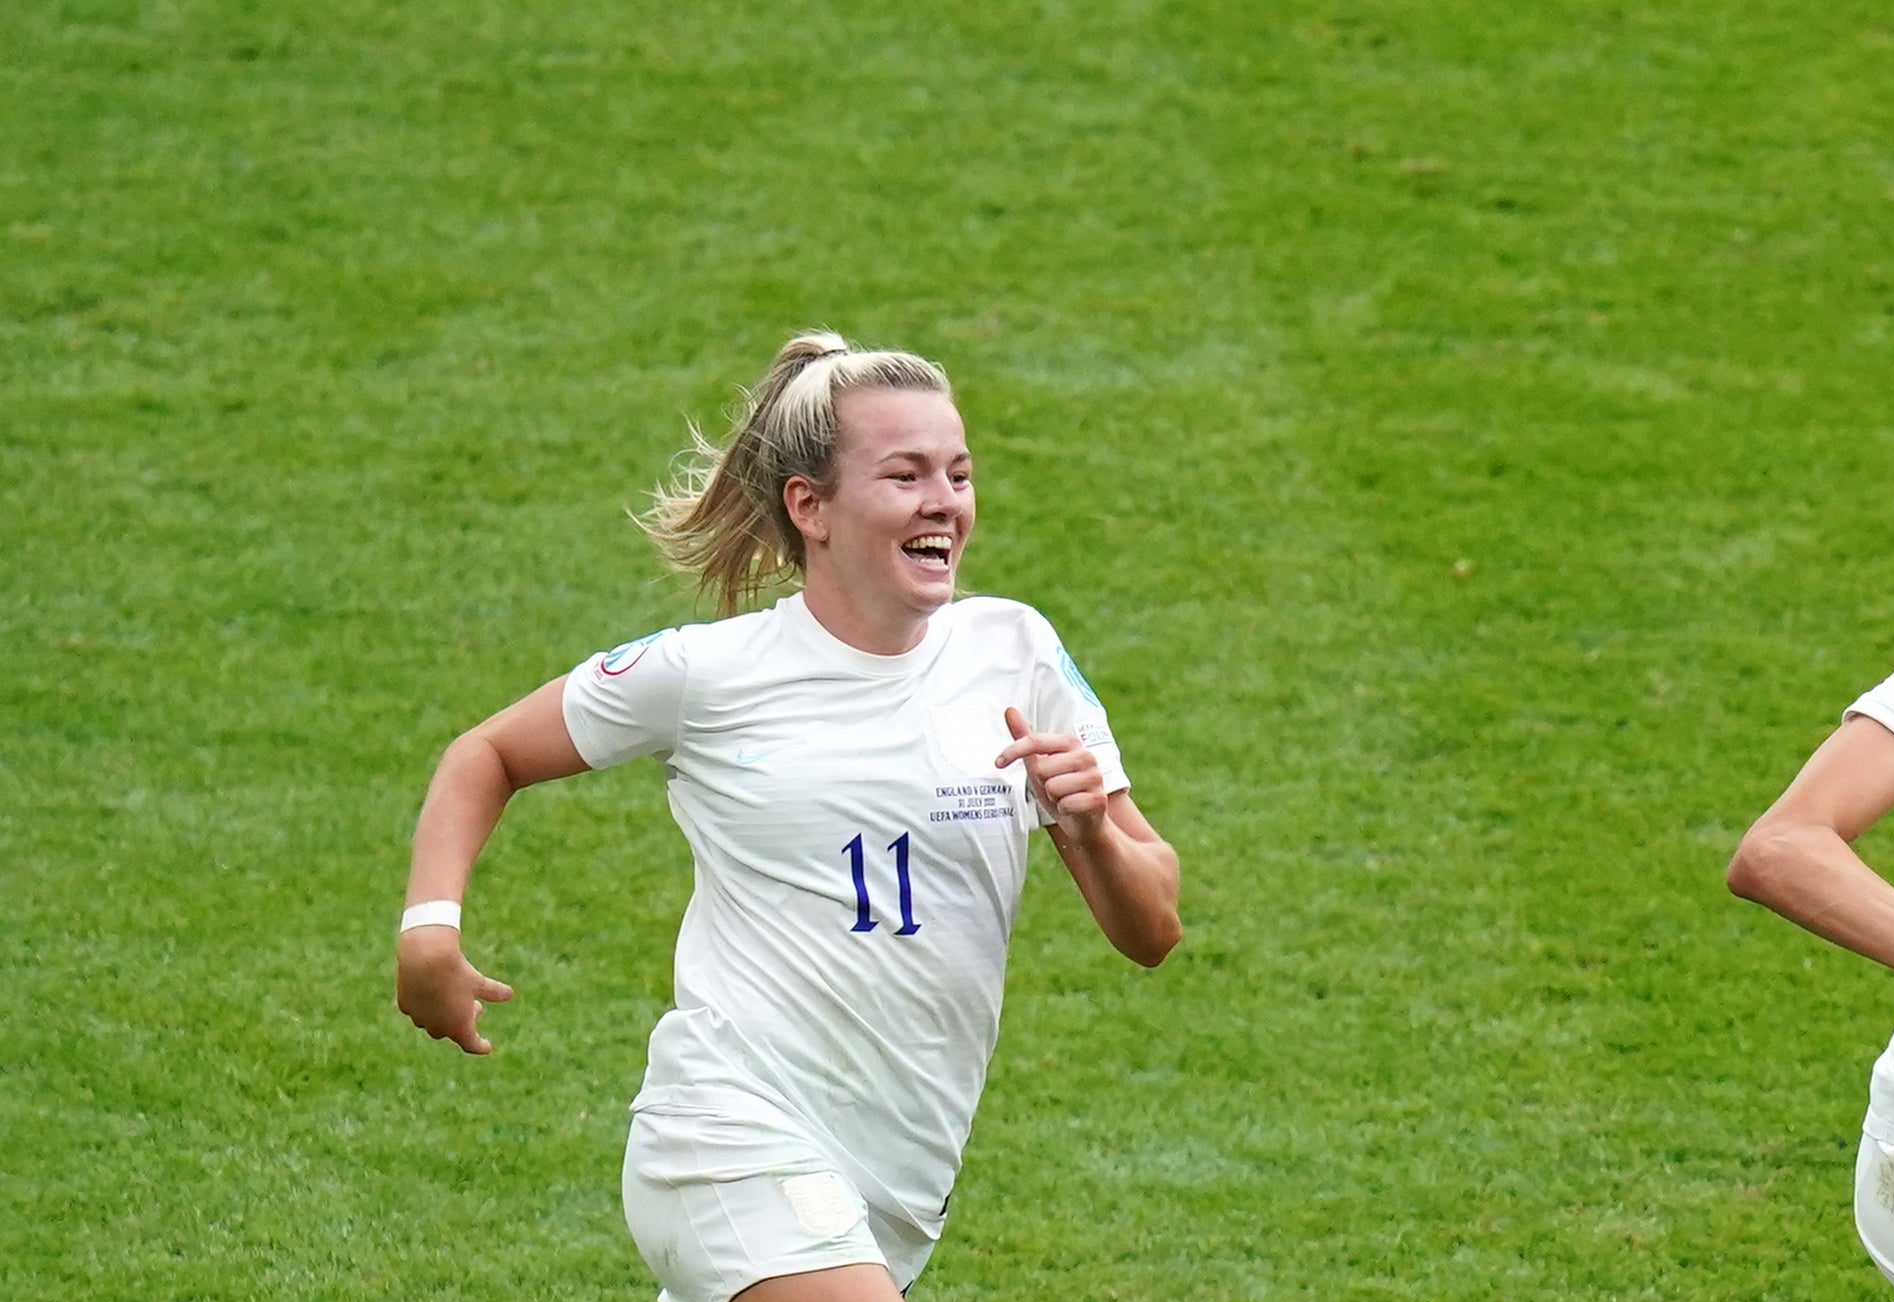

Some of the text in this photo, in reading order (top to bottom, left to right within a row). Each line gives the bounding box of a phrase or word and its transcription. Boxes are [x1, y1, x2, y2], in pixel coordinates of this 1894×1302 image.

[936, 784, 1012, 798] ENGLAND V GERMANY
[930, 811, 951, 822] UEFA
[952, 810, 982, 820] WOMENS
[841, 831, 922, 935] 11
